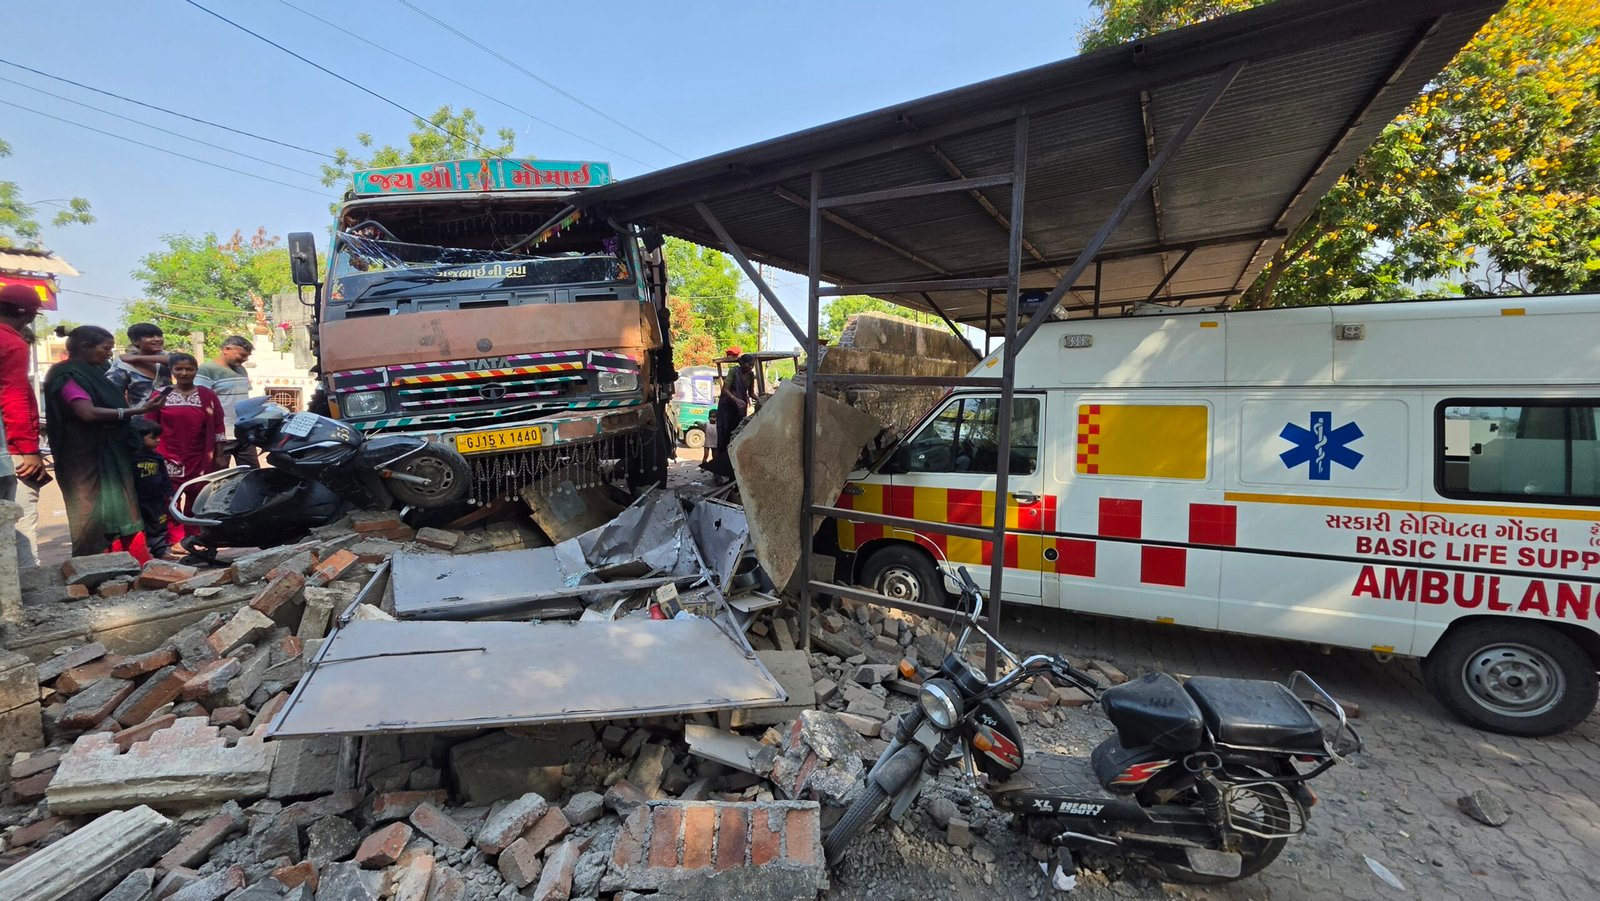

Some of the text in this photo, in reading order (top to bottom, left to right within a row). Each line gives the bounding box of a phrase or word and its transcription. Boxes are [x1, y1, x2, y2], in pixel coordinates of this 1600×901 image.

[369, 172, 415, 191] જય
[418, 164, 453, 191] શ્રી
[466, 357, 511, 371] TATA
[467, 429, 538, 448] GJ15 X 1440
[1325, 512, 1558, 543] સરકારી હોસ્પિટલ ગોંડલ
[1356, 535, 1600, 571] BASIC LIFE SUPP
[1351, 565, 1600, 621] AMBULAN
[1032, 799, 1053, 808] XL
[1059, 801, 1104, 811] HEAVY
